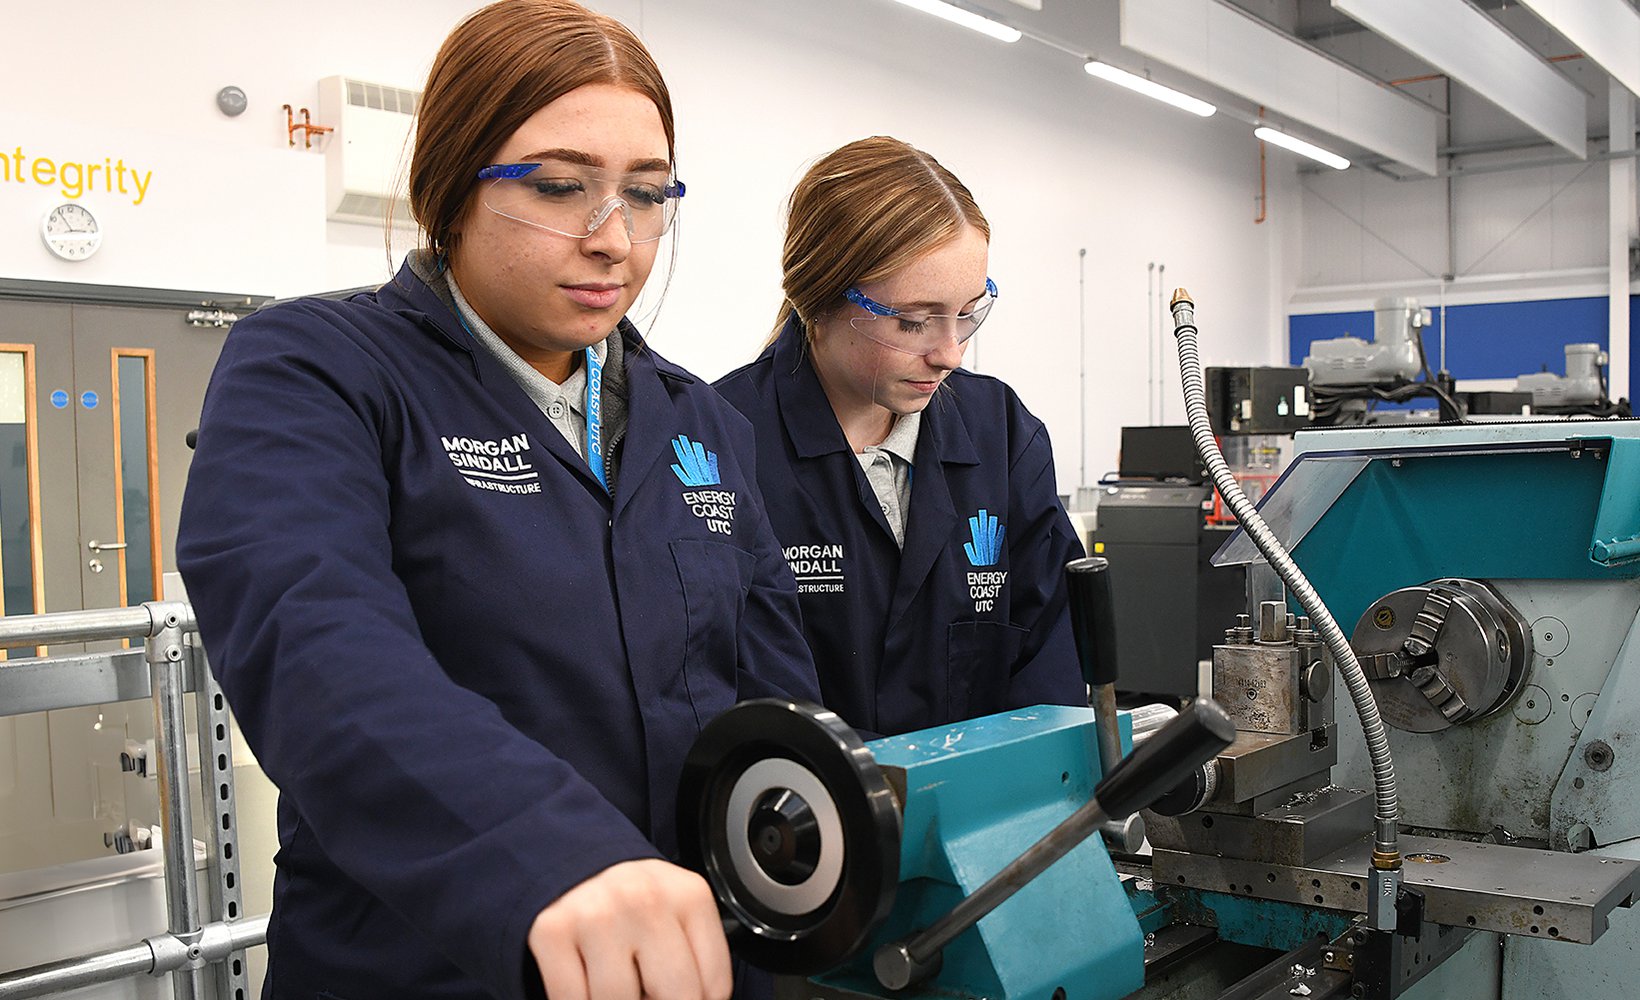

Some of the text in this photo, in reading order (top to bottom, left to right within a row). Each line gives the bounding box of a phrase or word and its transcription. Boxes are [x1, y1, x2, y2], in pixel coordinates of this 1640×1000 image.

[591, 367, 602, 420] COAST
[441, 433, 531, 456] MORGAN
[591, 422, 602, 456] UTC
[448, 453, 532, 472] SINDALL
[682, 490, 736, 505] ENERGY
[692, 504, 735, 520] COAST
[706, 519, 732, 535] UTC
[967, 571, 1008, 585] ENERGY
[797, 584, 845, 593] STRUCTURE
[970, 585, 1002, 599] COAST
[975, 599, 994, 613] UTC
